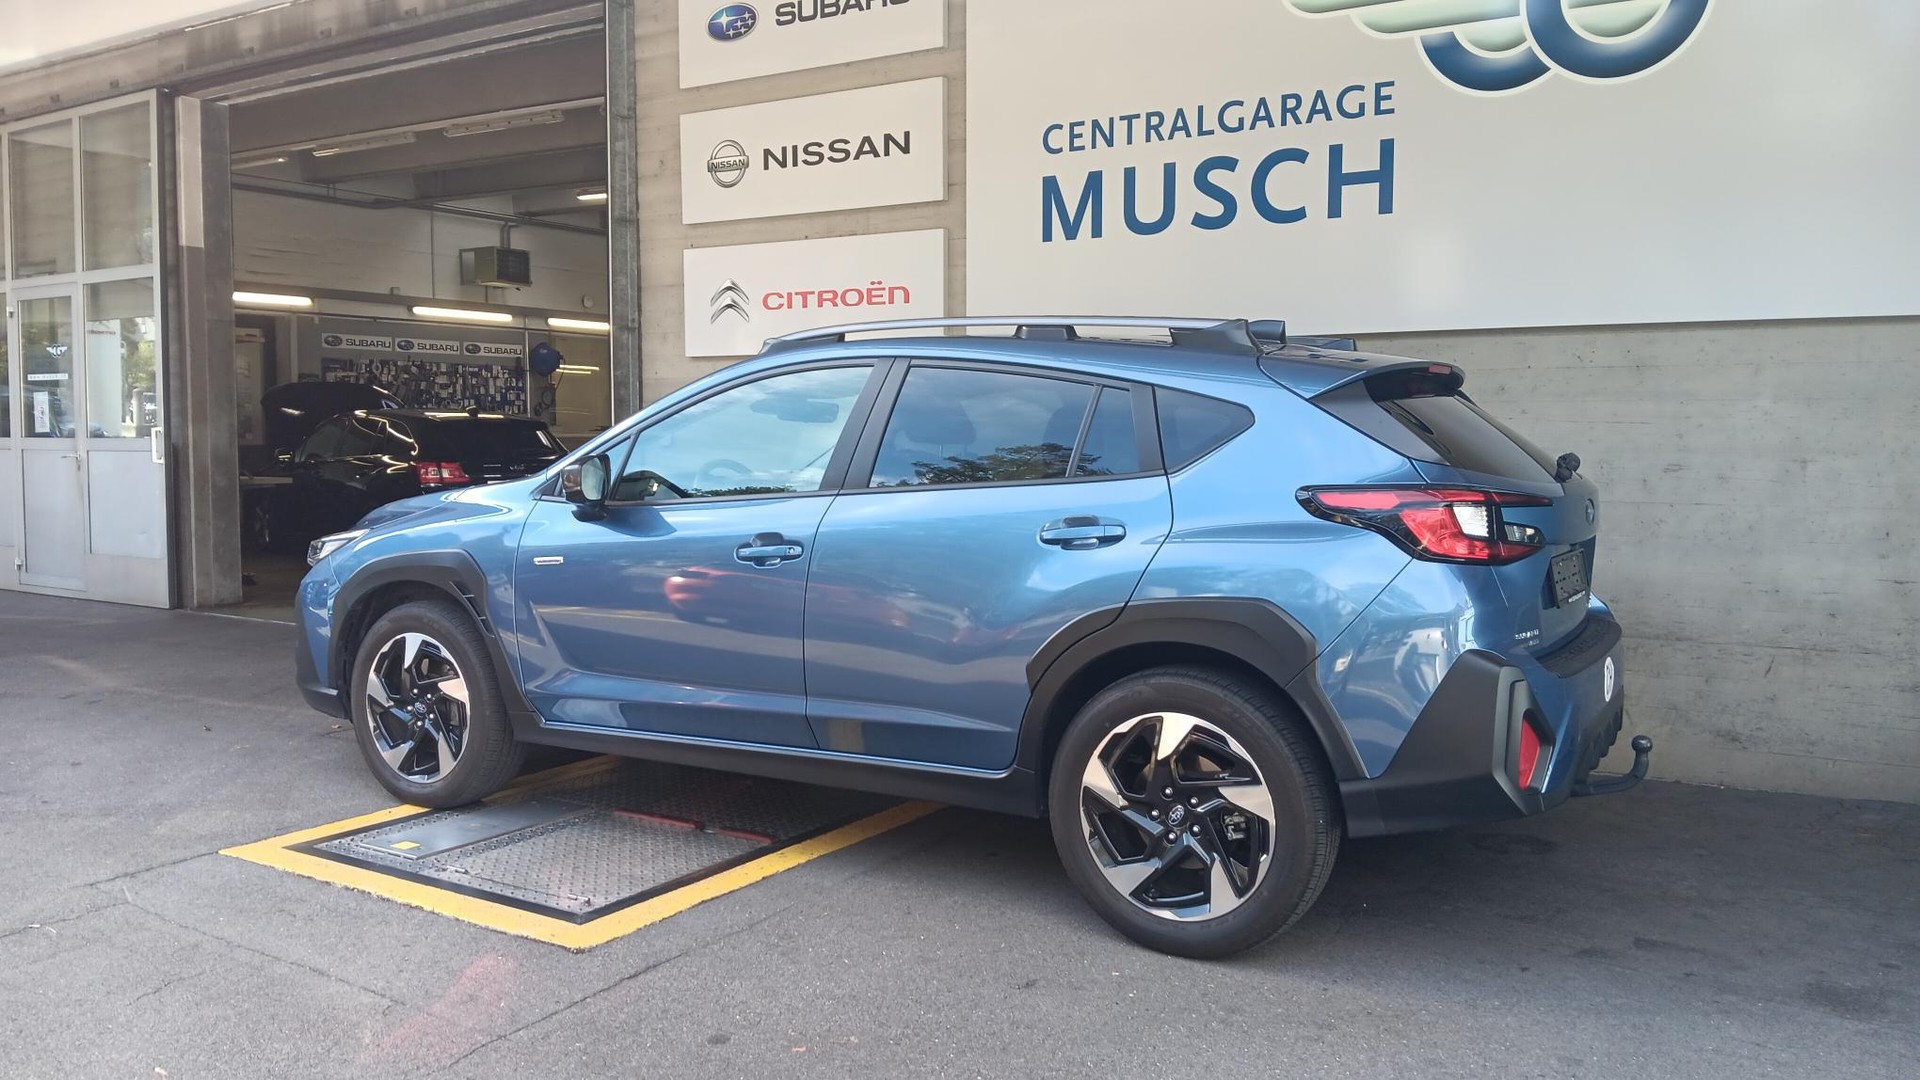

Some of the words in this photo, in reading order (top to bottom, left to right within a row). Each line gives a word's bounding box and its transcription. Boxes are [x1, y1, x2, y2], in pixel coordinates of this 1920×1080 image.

[775, 0, 910, 26] SUBA
[1042, 80, 1395, 155] CENTRALGARAGE
[763, 130, 911, 171] NISSAN
[711, 158, 745, 170] NISSAN
[1042, 138, 1395, 242] MUSCH
[345, 338, 391, 349] SUBARU
[417, 342, 459, 352] SUBARU
[483, 346, 522, 356] SUBARU
